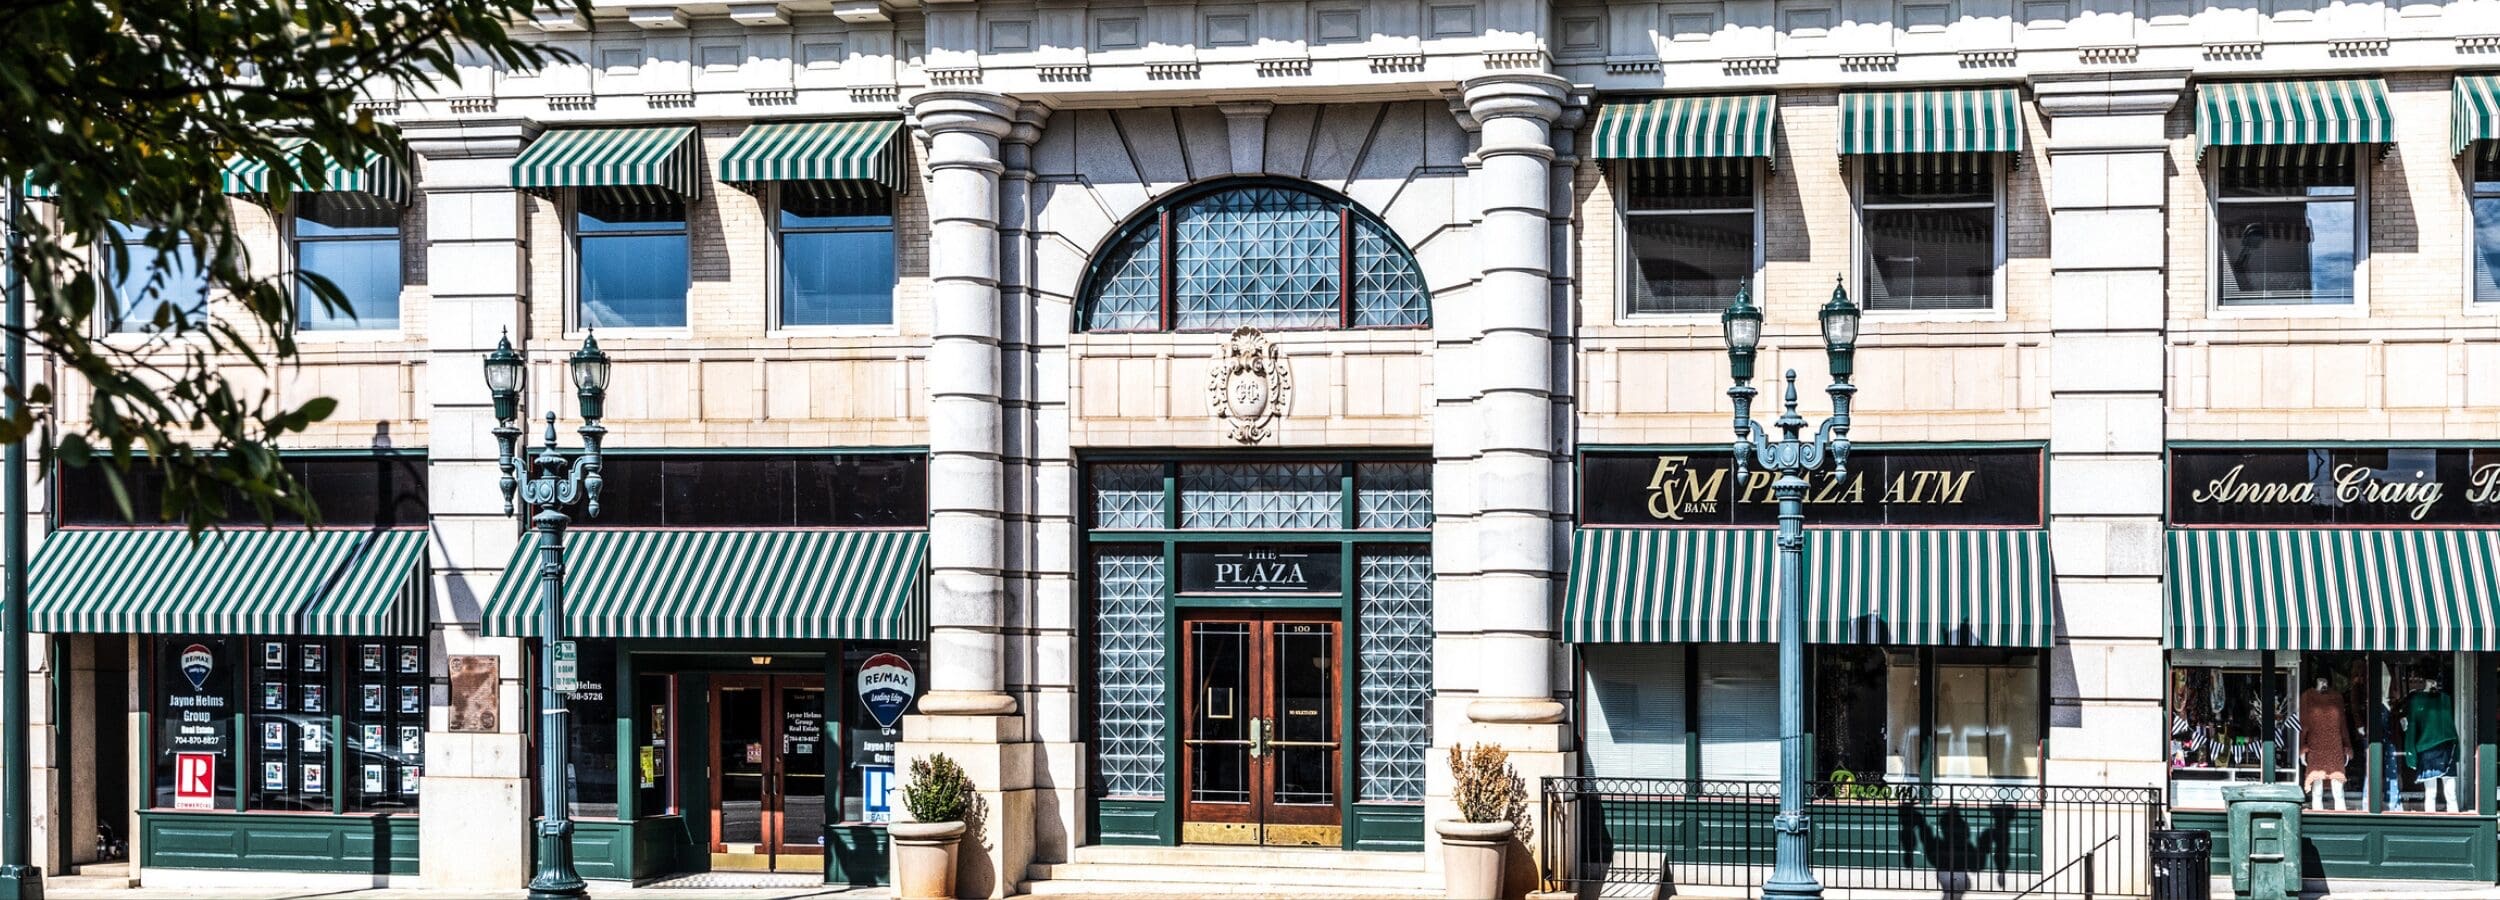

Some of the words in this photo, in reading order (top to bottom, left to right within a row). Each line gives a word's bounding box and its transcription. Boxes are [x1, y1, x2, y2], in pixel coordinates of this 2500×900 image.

[1879, 470, 1975, 503] ATM
[2192, 464, 2316, 503] Anna
[2333, 463, 2444, 520] Craig
[1684, 502, 1717, 513] BANK
[1247, 550, 1277, 560] THE
[1214, 562, 1308, 584] PLAZA
[1293, 625, 1311, 633] 100
[555, 645, 562, 659] 2
[185, 655, 209, 663] RE/MAX
[865, 672, 909, 687] RE/MAX
[170, 695, 194, 708] Jayne
[195, 695, 224, 706] Helms
[871, 692, 890, 703] Leading
[890, 693, 903, 704] Edge
[183, 710, 210, 723] Group
[181, 725, 195, 734] Real
[195, 725, 214, 734] Estate
[863, 741, 884, 752] Jayne
[866, 813, 891, 821] REALT
